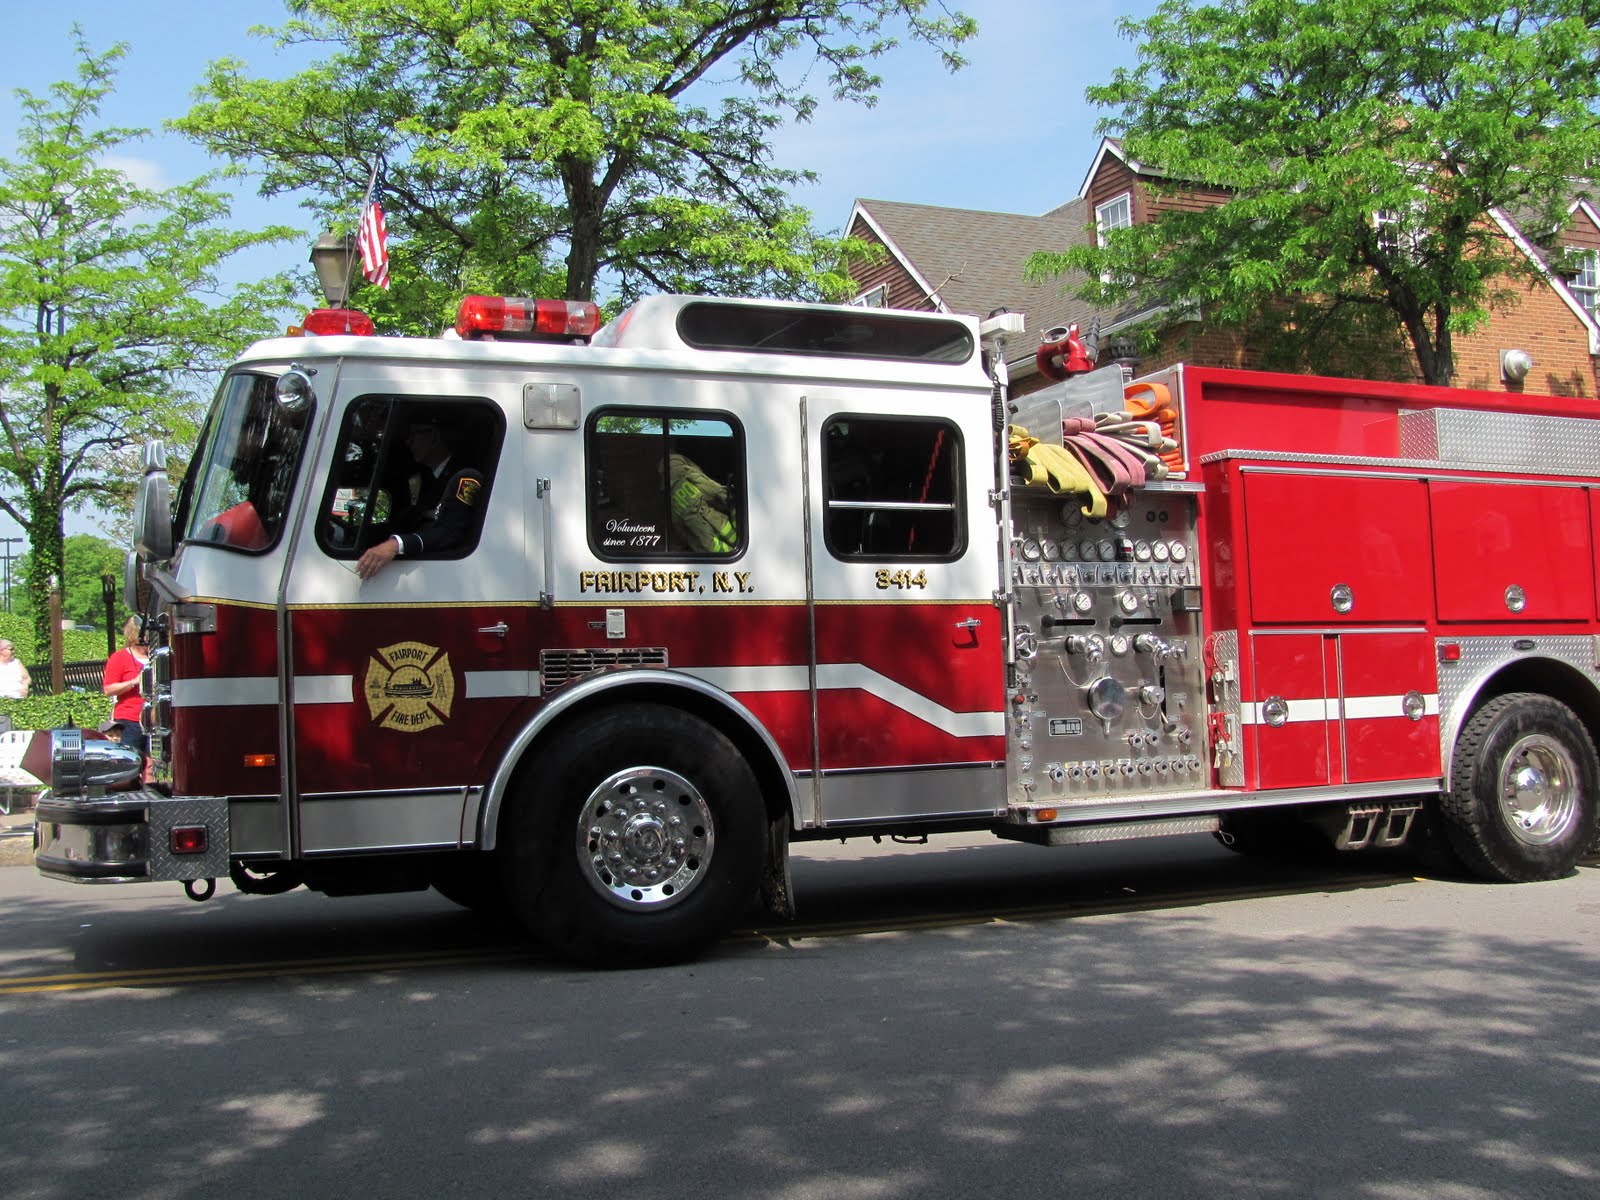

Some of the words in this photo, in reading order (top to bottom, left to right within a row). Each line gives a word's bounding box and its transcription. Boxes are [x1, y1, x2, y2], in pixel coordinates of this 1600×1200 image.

[606, 518, 656, 533] Volunteers
[603, 537, 626, 546] since
[630, 535, 661, 546] 1877
[580, 571, 705, 595] FAIRPORT,
[712, 571, 755, 593] N.Y.
[875, 569, 927, 590] 3414
[389, 648, 428, 662] FAIRPORT
[391, 710, 409, 725] FIRE
[411, 710, 433, 725] DEPT.
